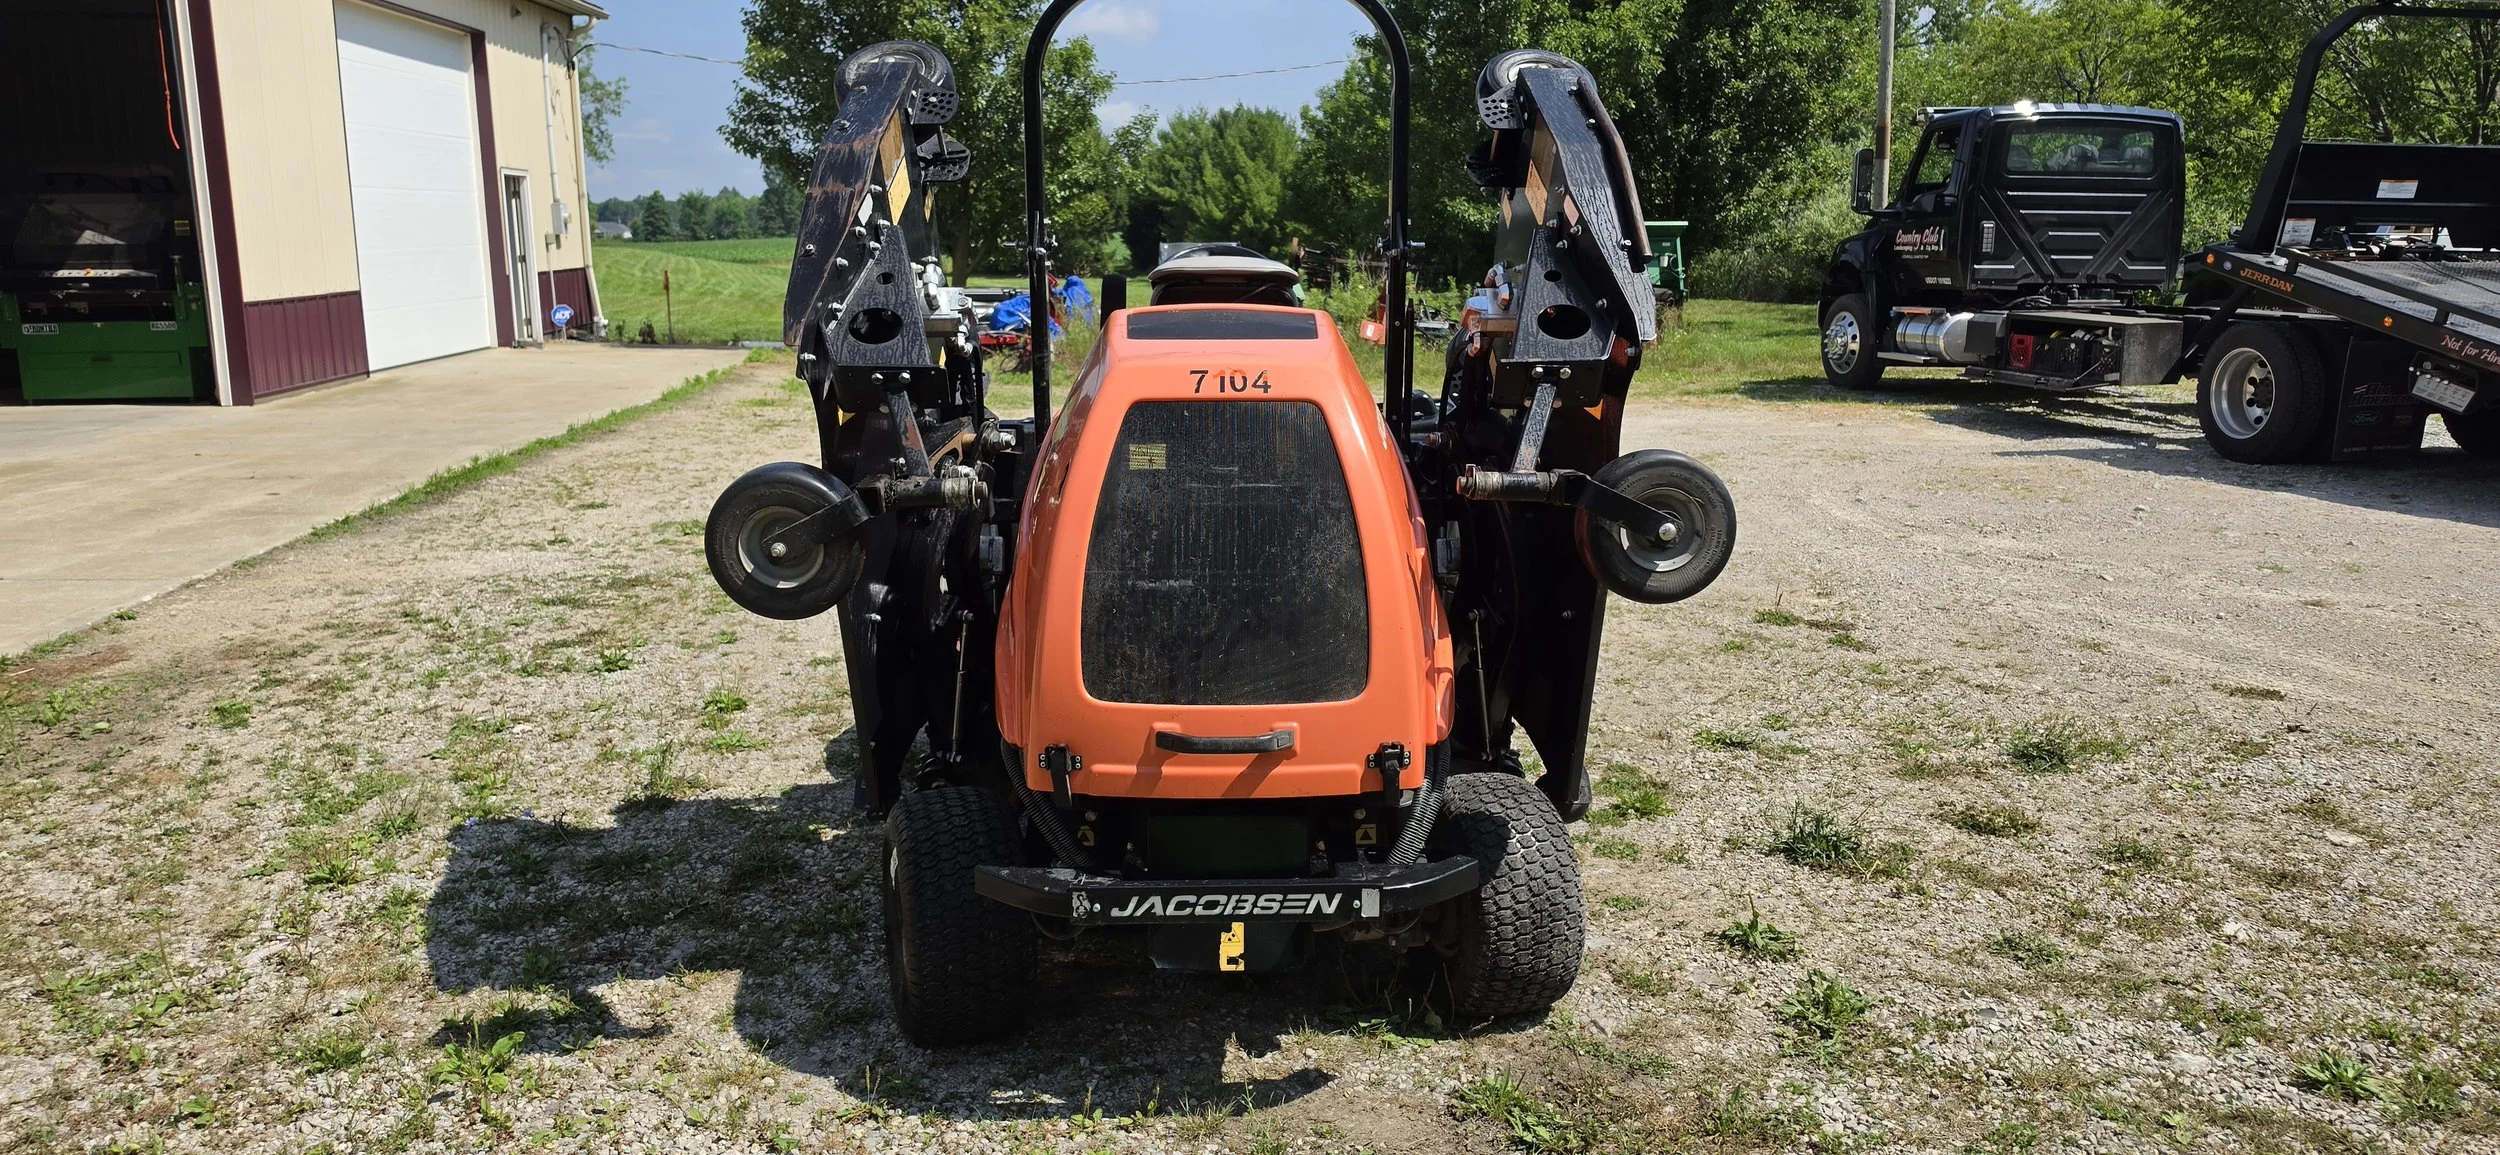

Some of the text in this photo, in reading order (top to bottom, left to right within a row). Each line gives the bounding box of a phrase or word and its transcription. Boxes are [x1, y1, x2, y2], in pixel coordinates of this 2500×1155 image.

[1896, 226, 1939, 250] Country Club
[2441, 334, 2463, 351] Not
[2461, 340, 2479, 357] for
[1189, 369, 1272, 394] 7104
[1110, 893, 1343, 917] JACOBSEN
